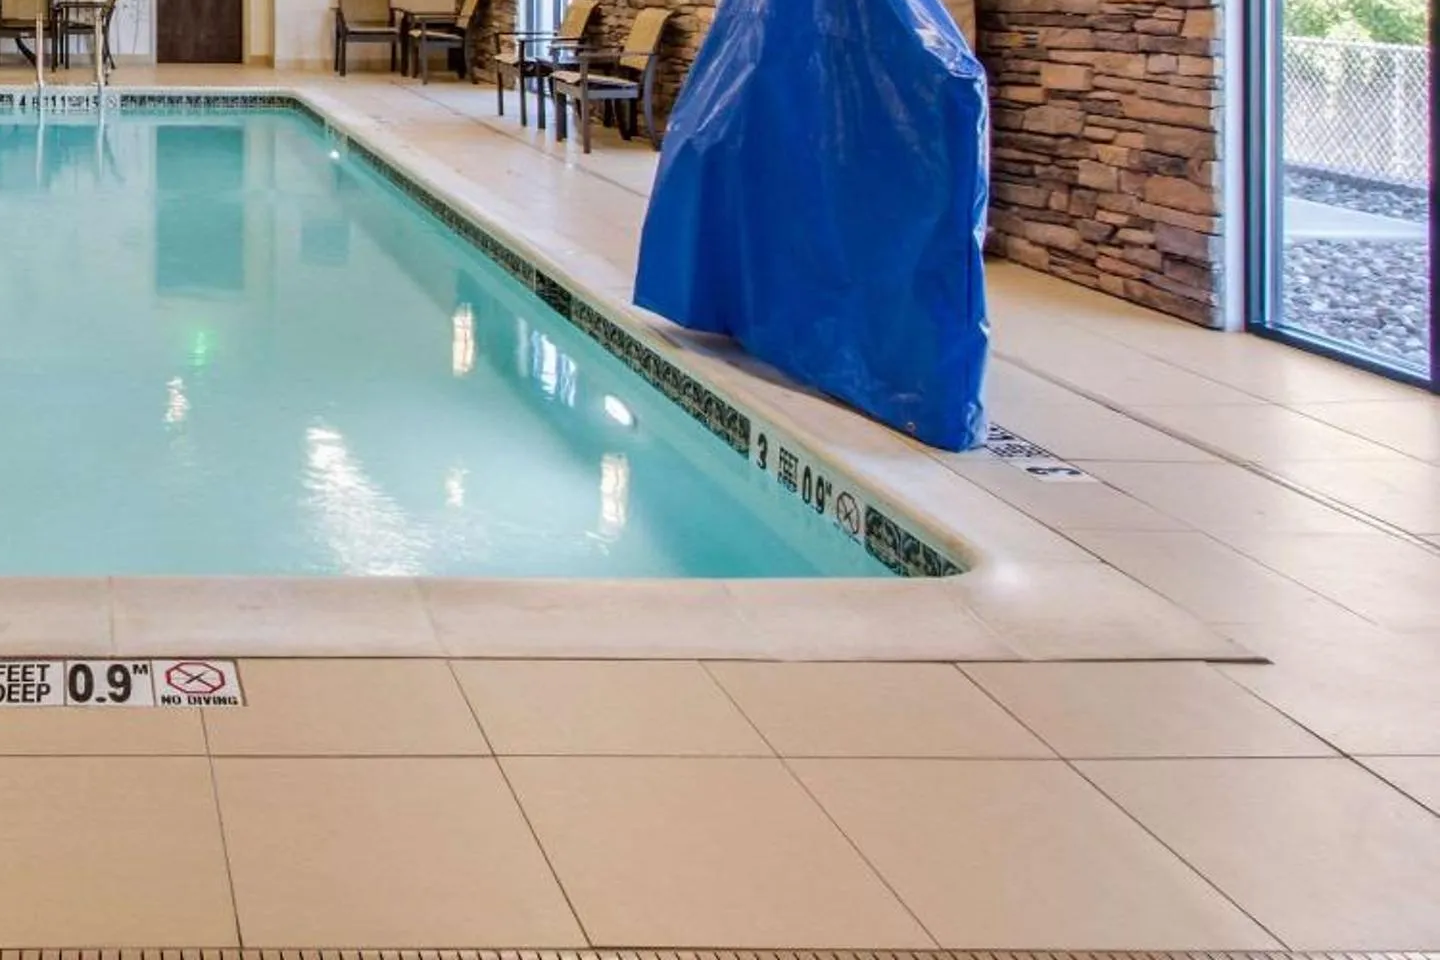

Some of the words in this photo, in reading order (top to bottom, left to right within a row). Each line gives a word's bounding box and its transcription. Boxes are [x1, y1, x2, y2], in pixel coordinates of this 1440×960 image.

[757, 432, 768, 470] 3
[161, 694, 182, 705] NO
[187, 696, 239, 706] DIVING
